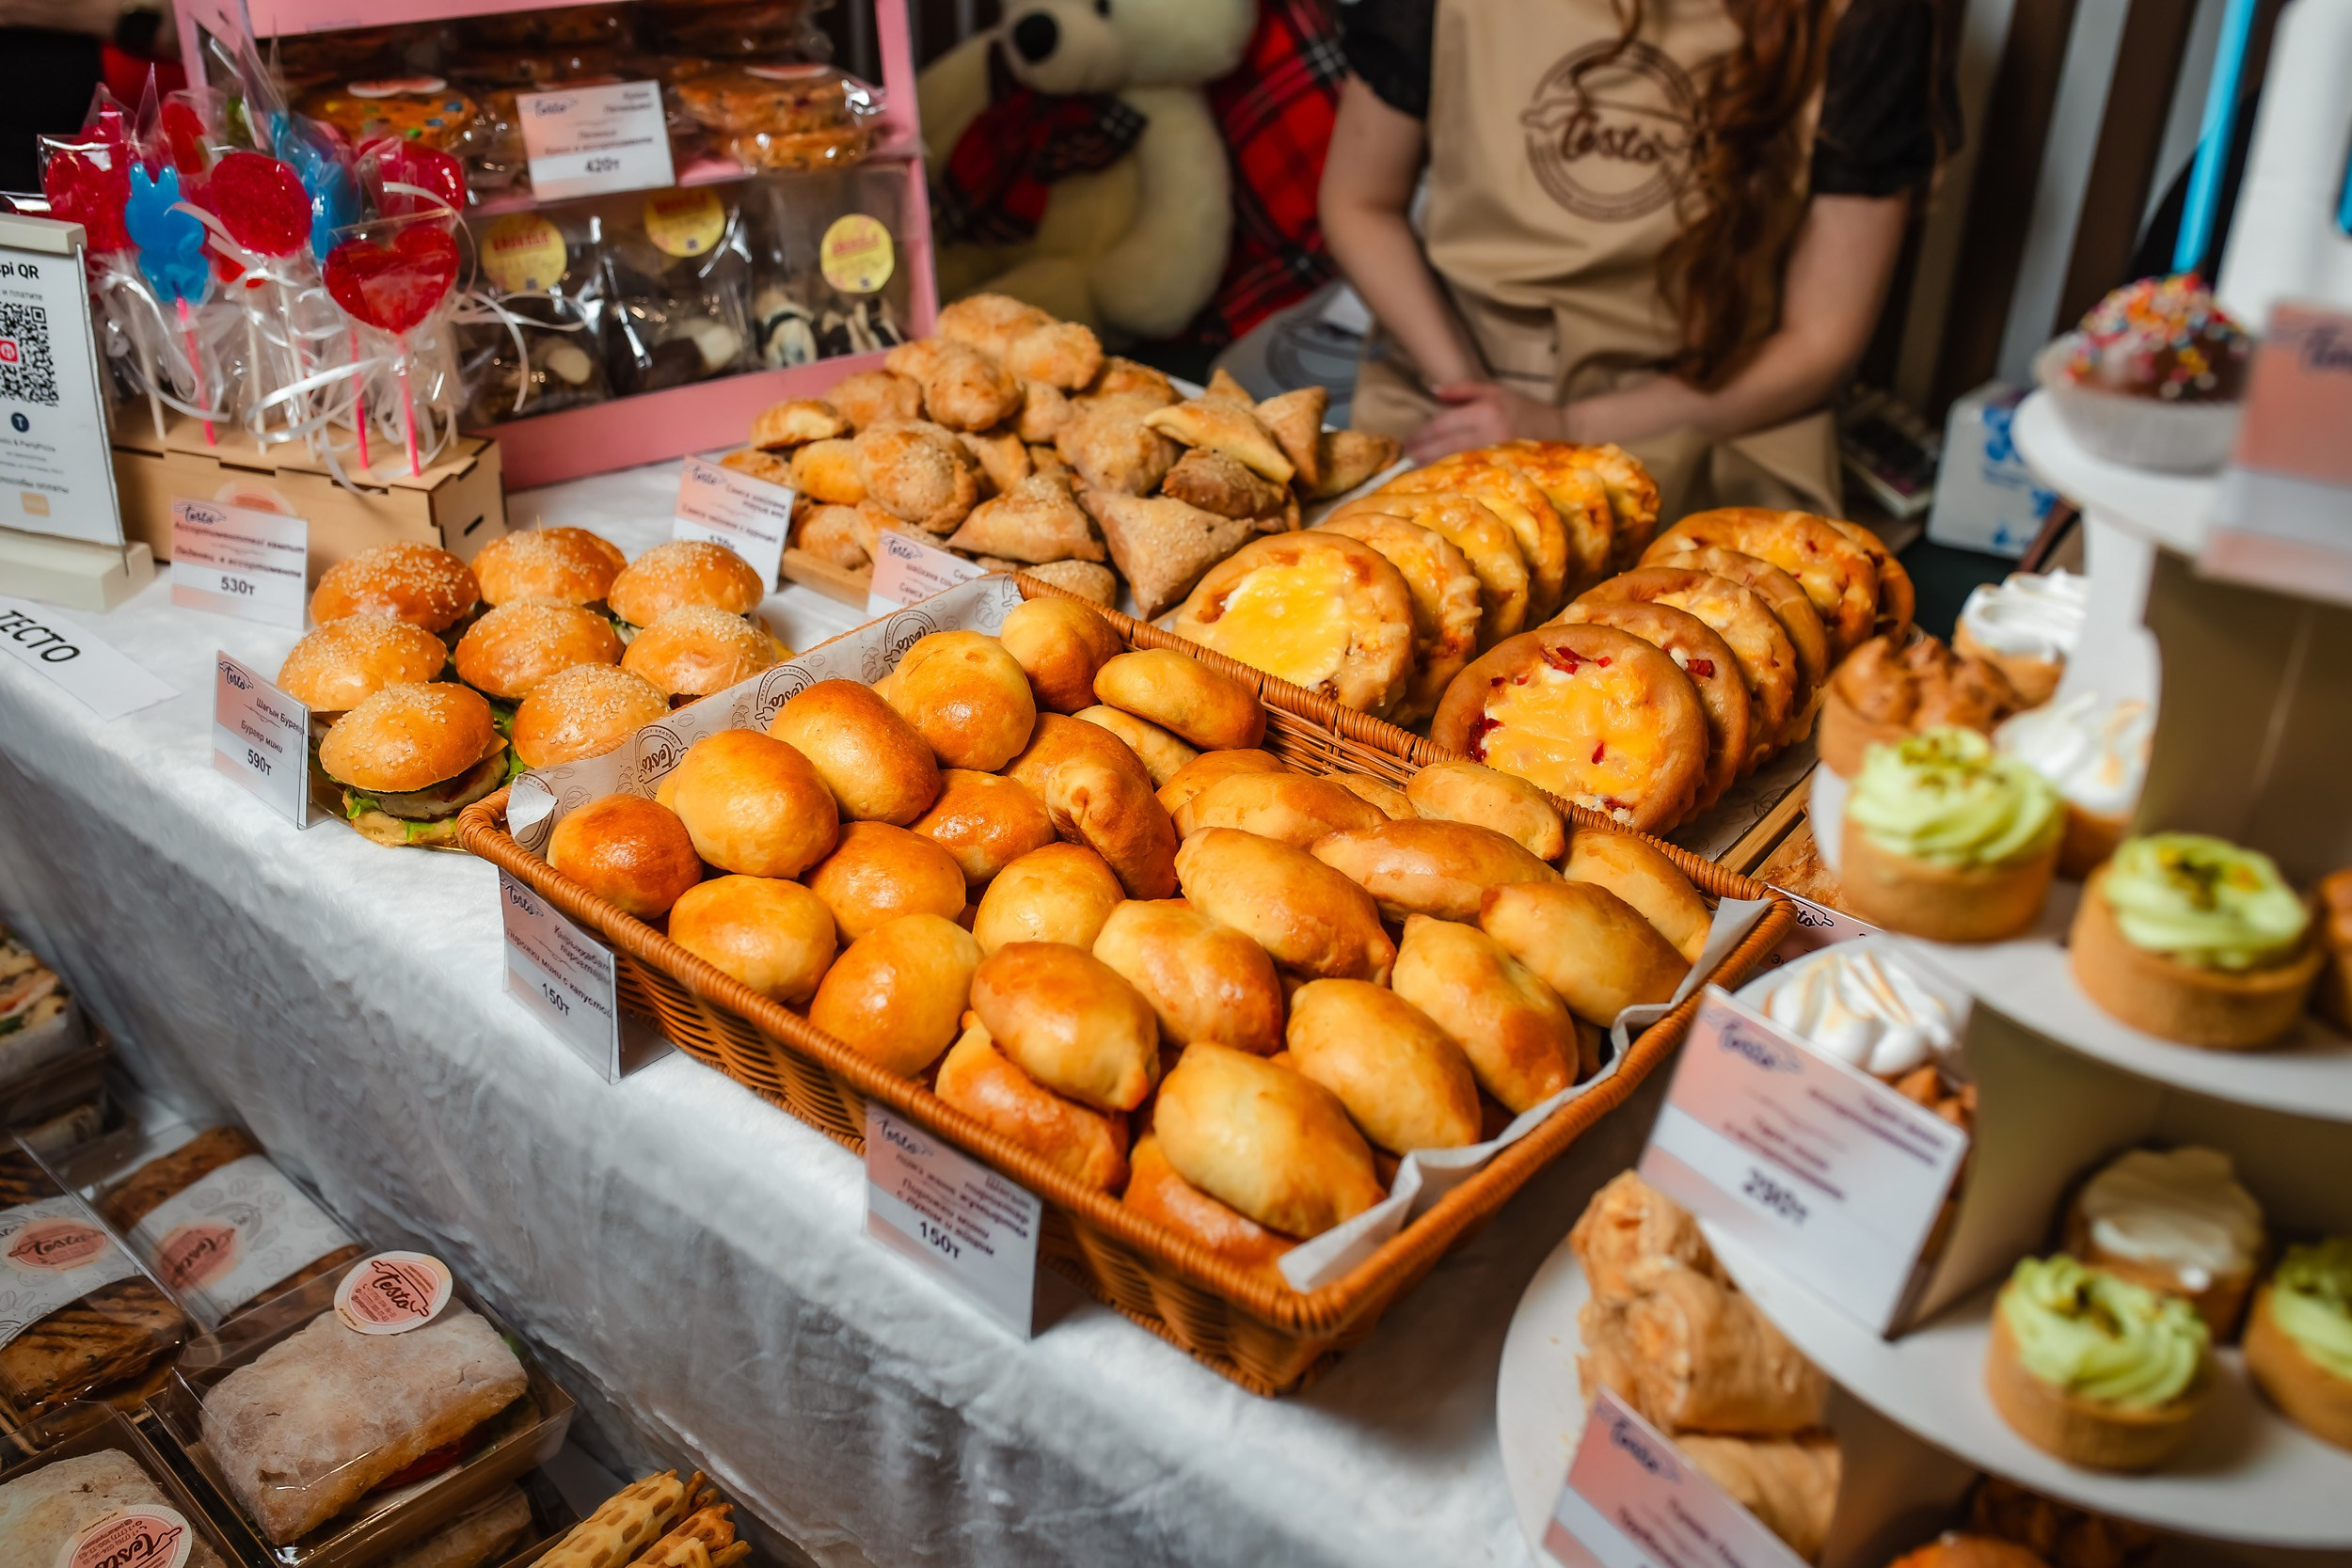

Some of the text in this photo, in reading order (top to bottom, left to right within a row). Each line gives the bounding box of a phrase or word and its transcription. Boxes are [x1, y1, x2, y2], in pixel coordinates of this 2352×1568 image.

[18, 263, 40, 279] QR
[221, 576, 256, 595] 530т
[0, 609, 81, 663] ТЕСТО
[241, 719, 284, 754] Бургер мини
[247, 748, 272, 777] 590т
[541, 958, 562, 979] мини
[569, 983, 612, 1019] капустой
[543, 983, 570, 1016] 150т
[920, 1220, 961, 1259] 150т
[372, 1273, 410, 1310] Testo
